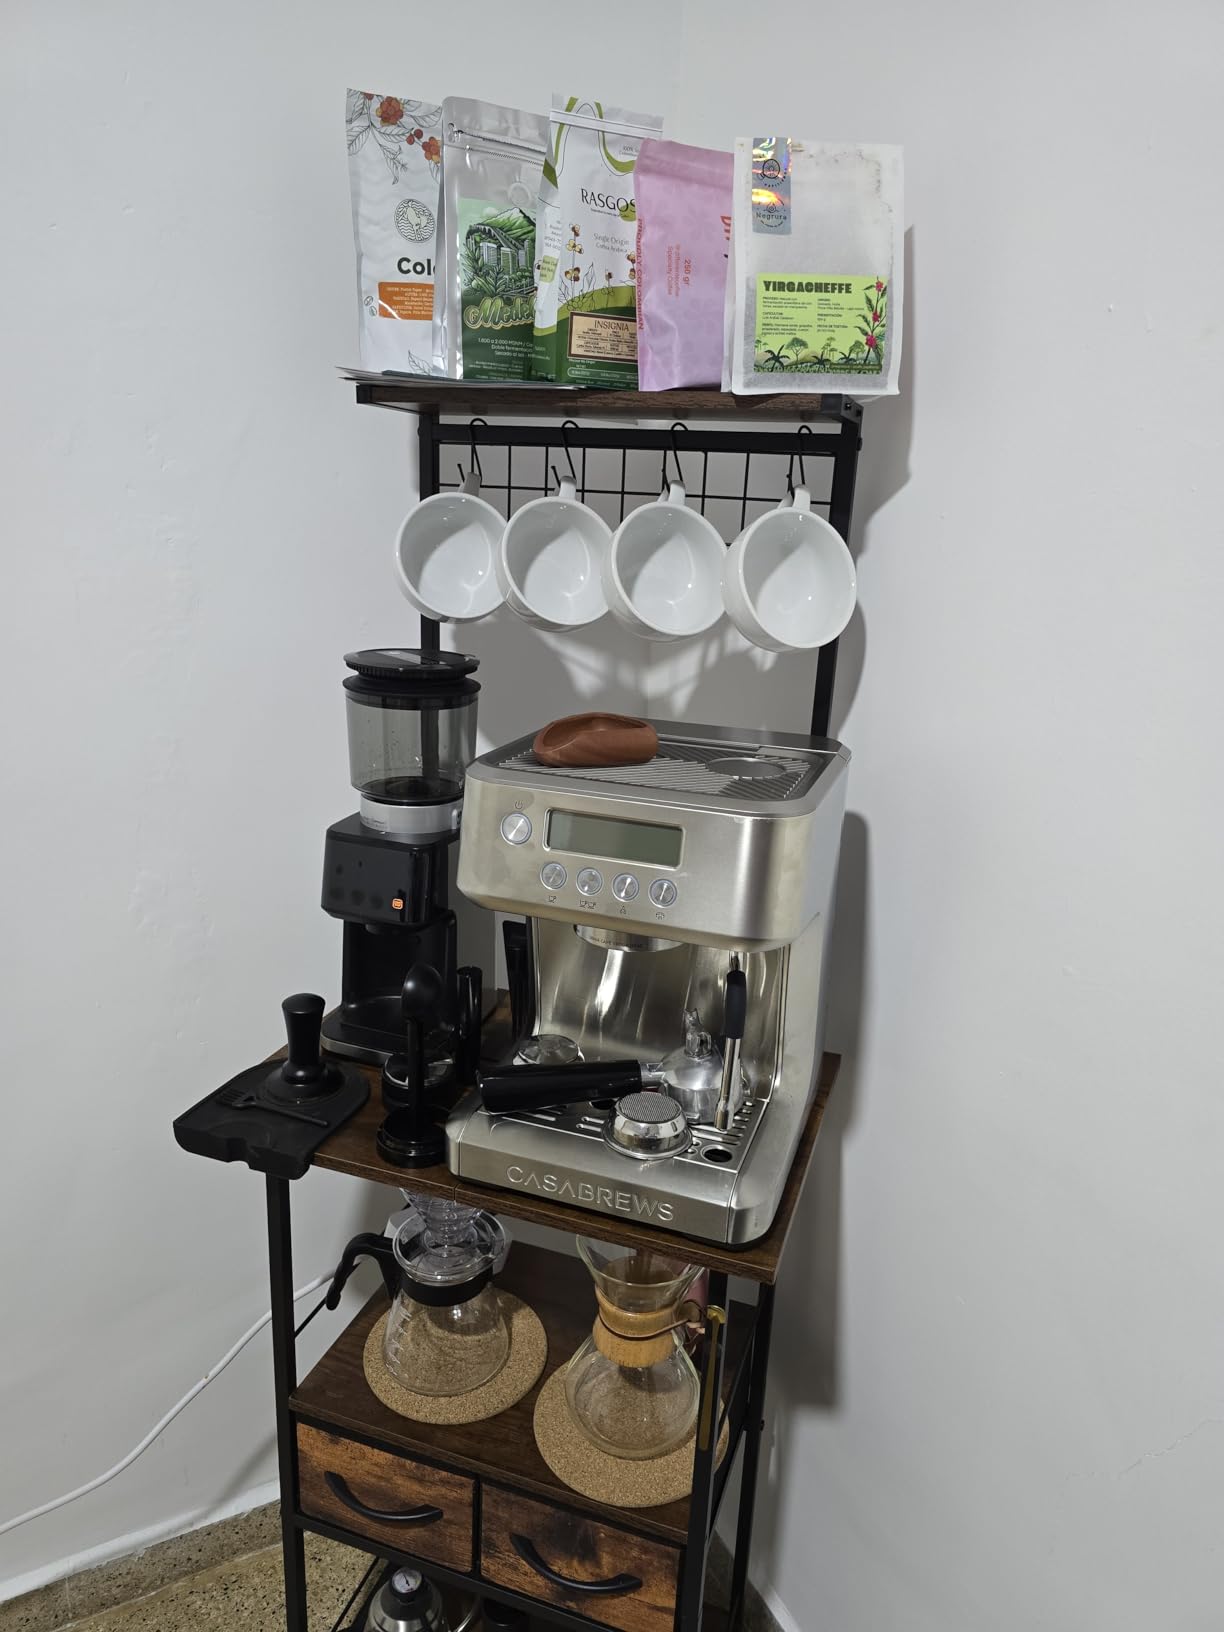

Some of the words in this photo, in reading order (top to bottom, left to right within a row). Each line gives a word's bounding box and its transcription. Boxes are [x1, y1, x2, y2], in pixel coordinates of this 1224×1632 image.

[581, 188, 636, 213] RASGOS
[756, 212, 787, 221] Negrura
[763, 280, 852, 294] YIRGACHEFFE
[594, 319, 630, 332] INSIGNIA
[506, 1166, 674, 1221] CASABREWS
